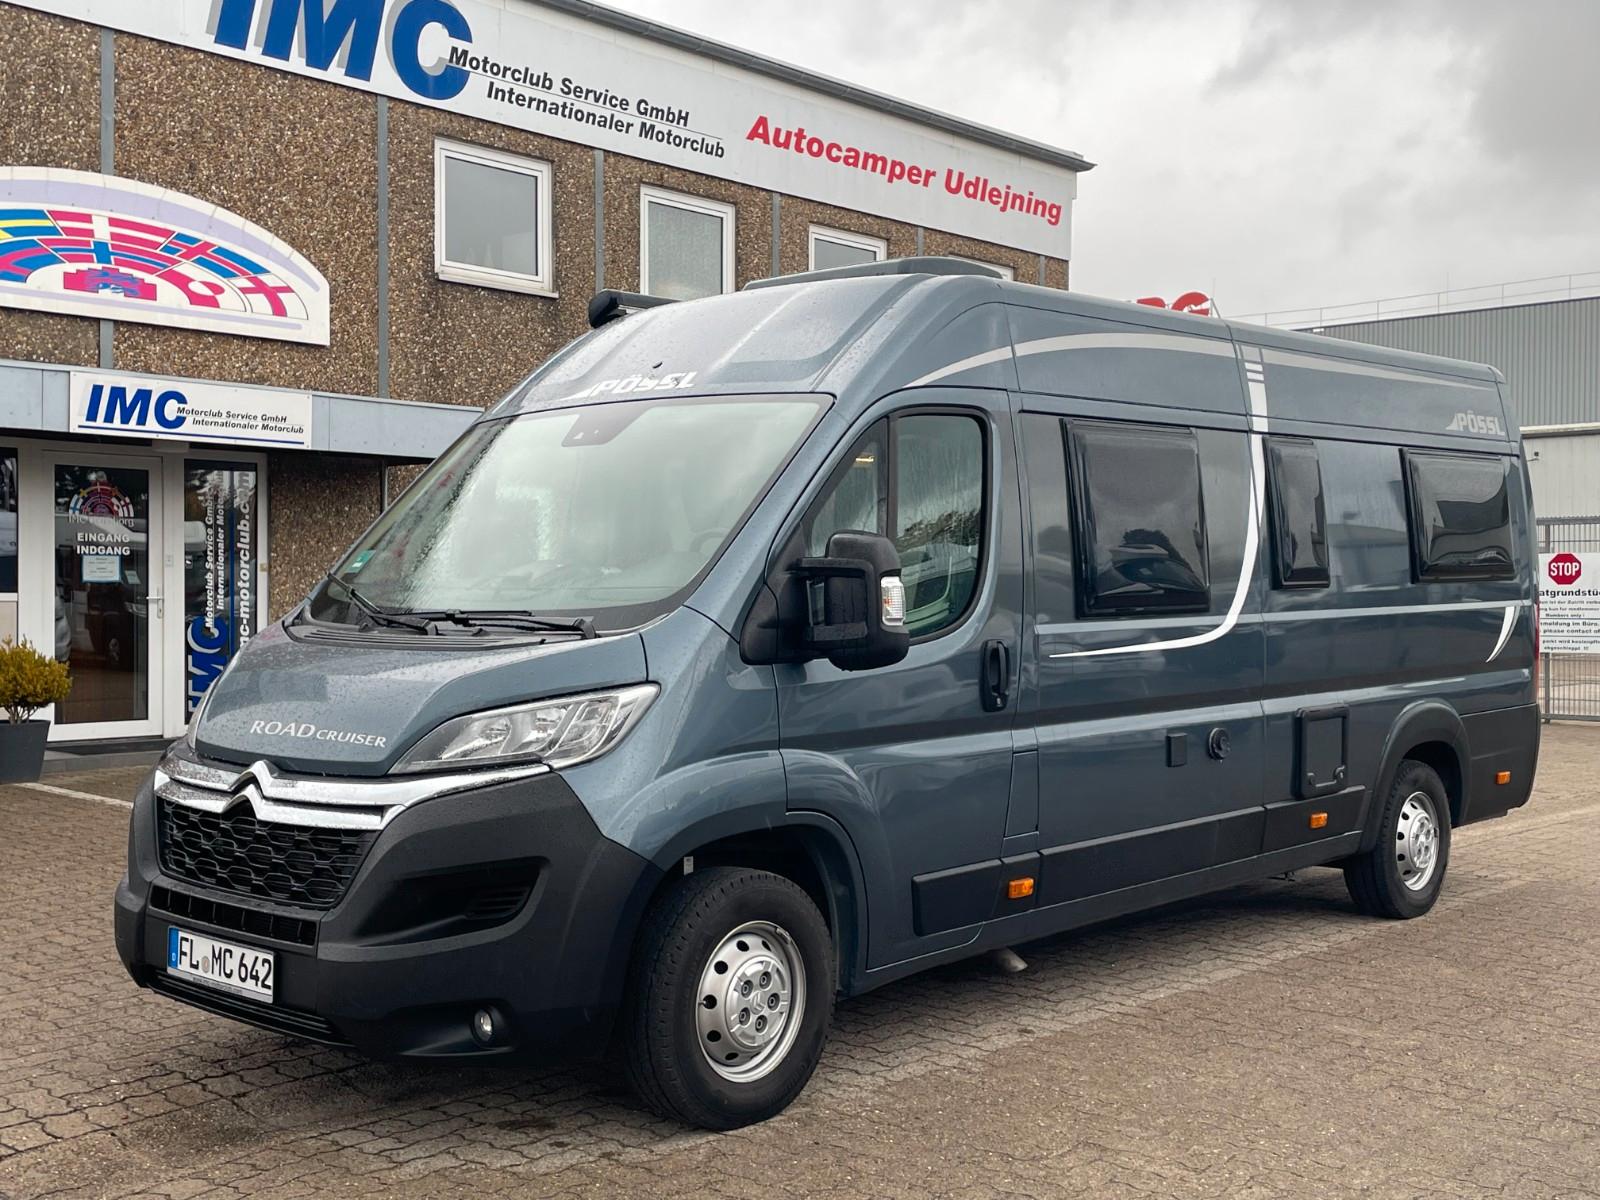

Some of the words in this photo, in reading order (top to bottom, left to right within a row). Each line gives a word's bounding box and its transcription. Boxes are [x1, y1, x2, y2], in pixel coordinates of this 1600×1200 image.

[206, 0, 473, 100] IMC
[449, 46, 553, 91] Motorclub
[560, 77, 629, 111] Service
[636, 98, 689, 127] GmbH
[487, 81, 634, 134] Internationaler
[638, 121, 725, 158] Motorclub
[746, 115, 937, 188] Autocamper
[944, 168, 1062, 226] Udlejning
[589, 371, 697, 398] PÖSSL
[85, 384, 188, 429] IMC
[176, 406, 223, 418] Motorclub
[225, 410, 258, 421] Service
[260, 413, 287, 423] GmbH
[192, 417, 258, 431] Internationaler
[260, 423, 304, 434] Motorclub
[1456, 410, 1505, 436] PÖSSL
[76, 545, 130, 556] INDGANG
[77, 532, 130, 542] EINGANG
[205, 528, 213, 570] Service
[217, 528, 225, 610] Internationaler
[1550, 562, 1580, 576] STOP
[205, 571, 213, 628] Motorclub
[187, 615, 229, 712] MC
[250, 720, 316, 738] ROAD
[316, 729, 388, 748] CRUISER
[179, 936, 199, 971] FL
[211, 944, 234, 979] MC
[238, 952, 272, 990] 642
